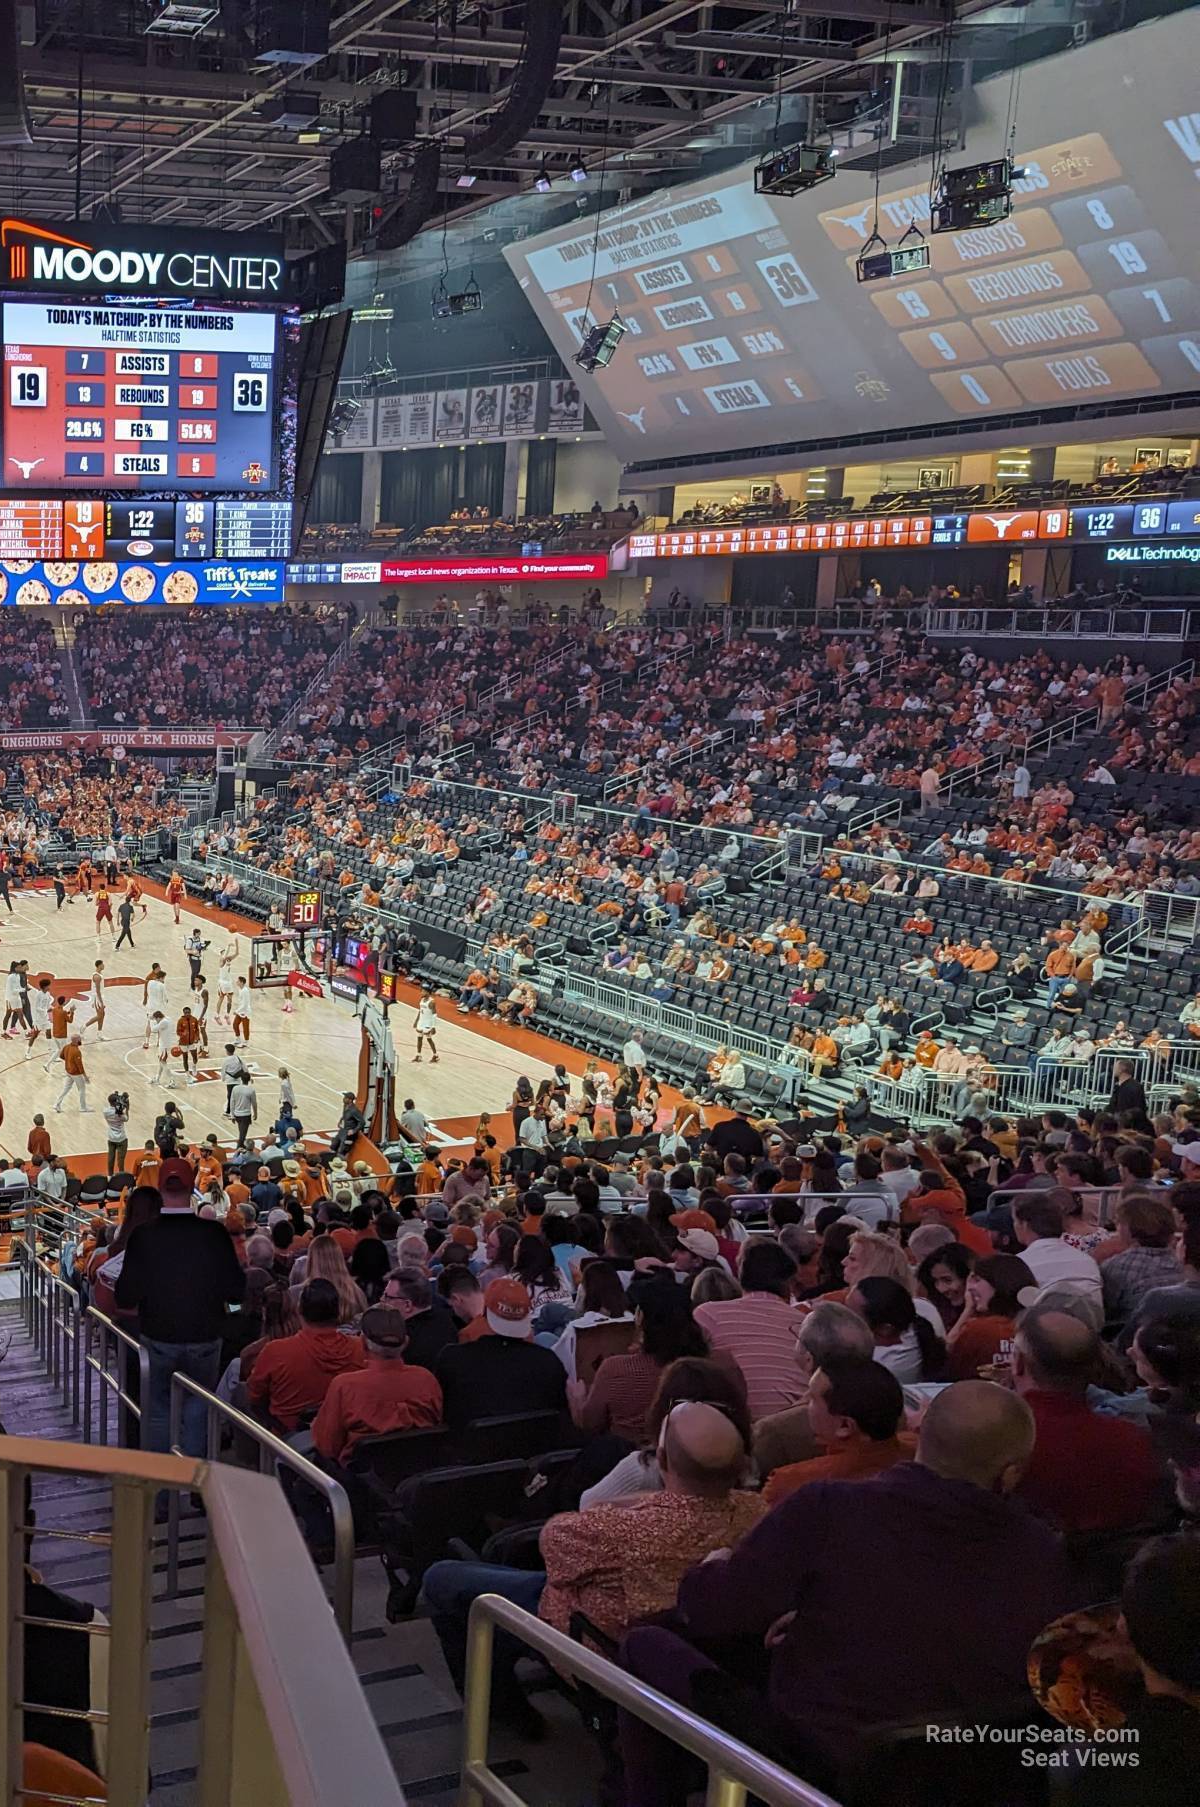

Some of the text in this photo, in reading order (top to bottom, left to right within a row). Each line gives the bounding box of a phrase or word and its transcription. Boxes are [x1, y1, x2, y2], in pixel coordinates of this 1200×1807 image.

[671, 197, 723, 226] NUMBERS
[1086, 199, 1114, 230] 8
[952, 222, 1026, 261] ASSISTS
[1108, 241, 1148, 275] 19
[33, 246, 281, 291] MOODY CENTER
[641, 266, 685, 290] ASSISTS
[766, 262, 810, 299] 36
[966, 260, 1063, 303] REBOUNDS
[896, 290, 930, 319] 13
[1142, 289, 1172, 323] 7
[46, 309, 234, 330] TODAY'S MATCHUP: BY THE NUMBERS
[990, 304, 1100, 348] TURNOVERS
[101, 329, 181, 344] HALFTIME STATISTICS
[5, 345, 20, 354] TEXAS
[929, 332, 957, 360] 9
[81, 353, 89, 370] 7
[120, 355, 165, 372] ASSISTS
[194, 357, 202, 373] 8
[1046, 355, 1112, 393] FOULS
[17, 373, 40, 401] 19
[78, 386, 91, 402] 13
[120, 388, 164, 404] REBOUNDS
[237, 379, 263, 406] 36
[785, 377, 803, 398] 5
[192, 389, 204, 405] 19
[714, 384, 759, 409] STEALS
[79, 456, 88, 472] 4
[122, 457, 160, 472] STEALS
[192, 458, 200, 473] 5
[242, 468, 268, 480] STATE
[76, 502, 93, 523] 19
[128, 510, 154, 528] 1:22
[185, 502, 205, 524] 36
[1087, 512, 1114, 530] 1:22
[1140, 508, 1160, 528] 36
[1046, 513, 1062, 533] 19
[633, 536, 655, 546] TEXAS
[1107, 547, 1141, 561] DELL
[203, 567, 277, 581] Tiff's Treats
[344, 572, 377, 580] IMPACT
[384, 568, 396, 576] The
[396, 567, 418, 577] largest
[418, 567, 433, 575] local
[450, 566, 491, 577] organization
[491, 566, 498, 574] in
[499, 566, 519, 574] Texas.
[558, 564, 595, 573] community
[101, 734, 137, 745] HOOK
[170, 734, 215, 745] HORNS
[300, 893, 318, 904] 1:22
[293, 904, 315, 922] 30
[331, 980, 357, 996] NISSAN
[497, 1302, 525, 1315] TEXAS
